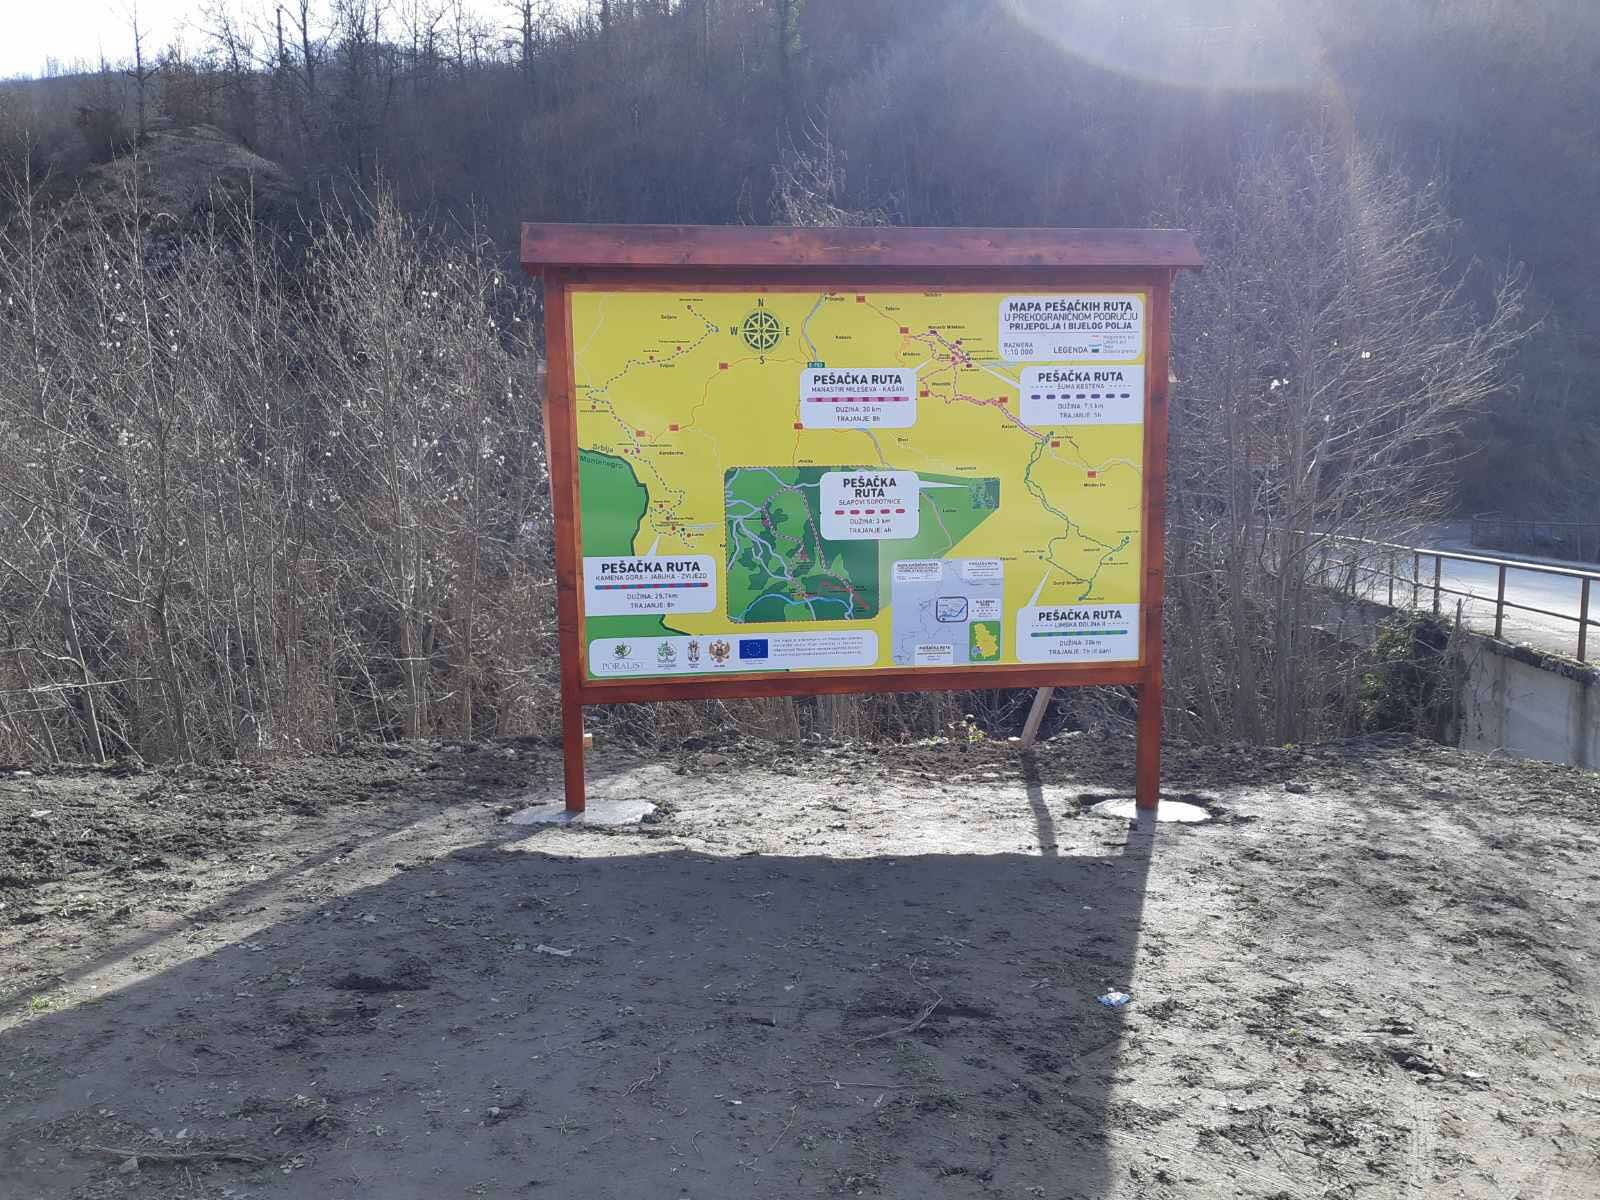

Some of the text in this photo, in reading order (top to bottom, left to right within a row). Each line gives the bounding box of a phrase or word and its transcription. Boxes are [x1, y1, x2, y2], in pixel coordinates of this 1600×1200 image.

[758, 298, 764, 307] N
[1009, 299, 1132, 312] MAPA PEŠAČKIH RUTA
[1004, 310, 1138, 321] U PREKOGRANIČNOM PODRUČJU
[730, 326, 738, 336] W
[785, 327, 790, 336] E
[1009, 322, 1061, 330] PRIJEPOLJA
[760, 355, 765, 365] S
[814, 372, 902, 384] PEŠAČKA RUTA
[1038, 370, 1123, 382] PEŠAČKA RUTA
[580, 456, 623, 469] Montenegro
[843, 475, 896, 488] PEŠAČKA
[855, 488, 885, 498] RUTA
[601, 560, 700, 573] PEŠAČKA RUTA
[1038, 609, 1122, 621] PEŠAČKA RUTA
